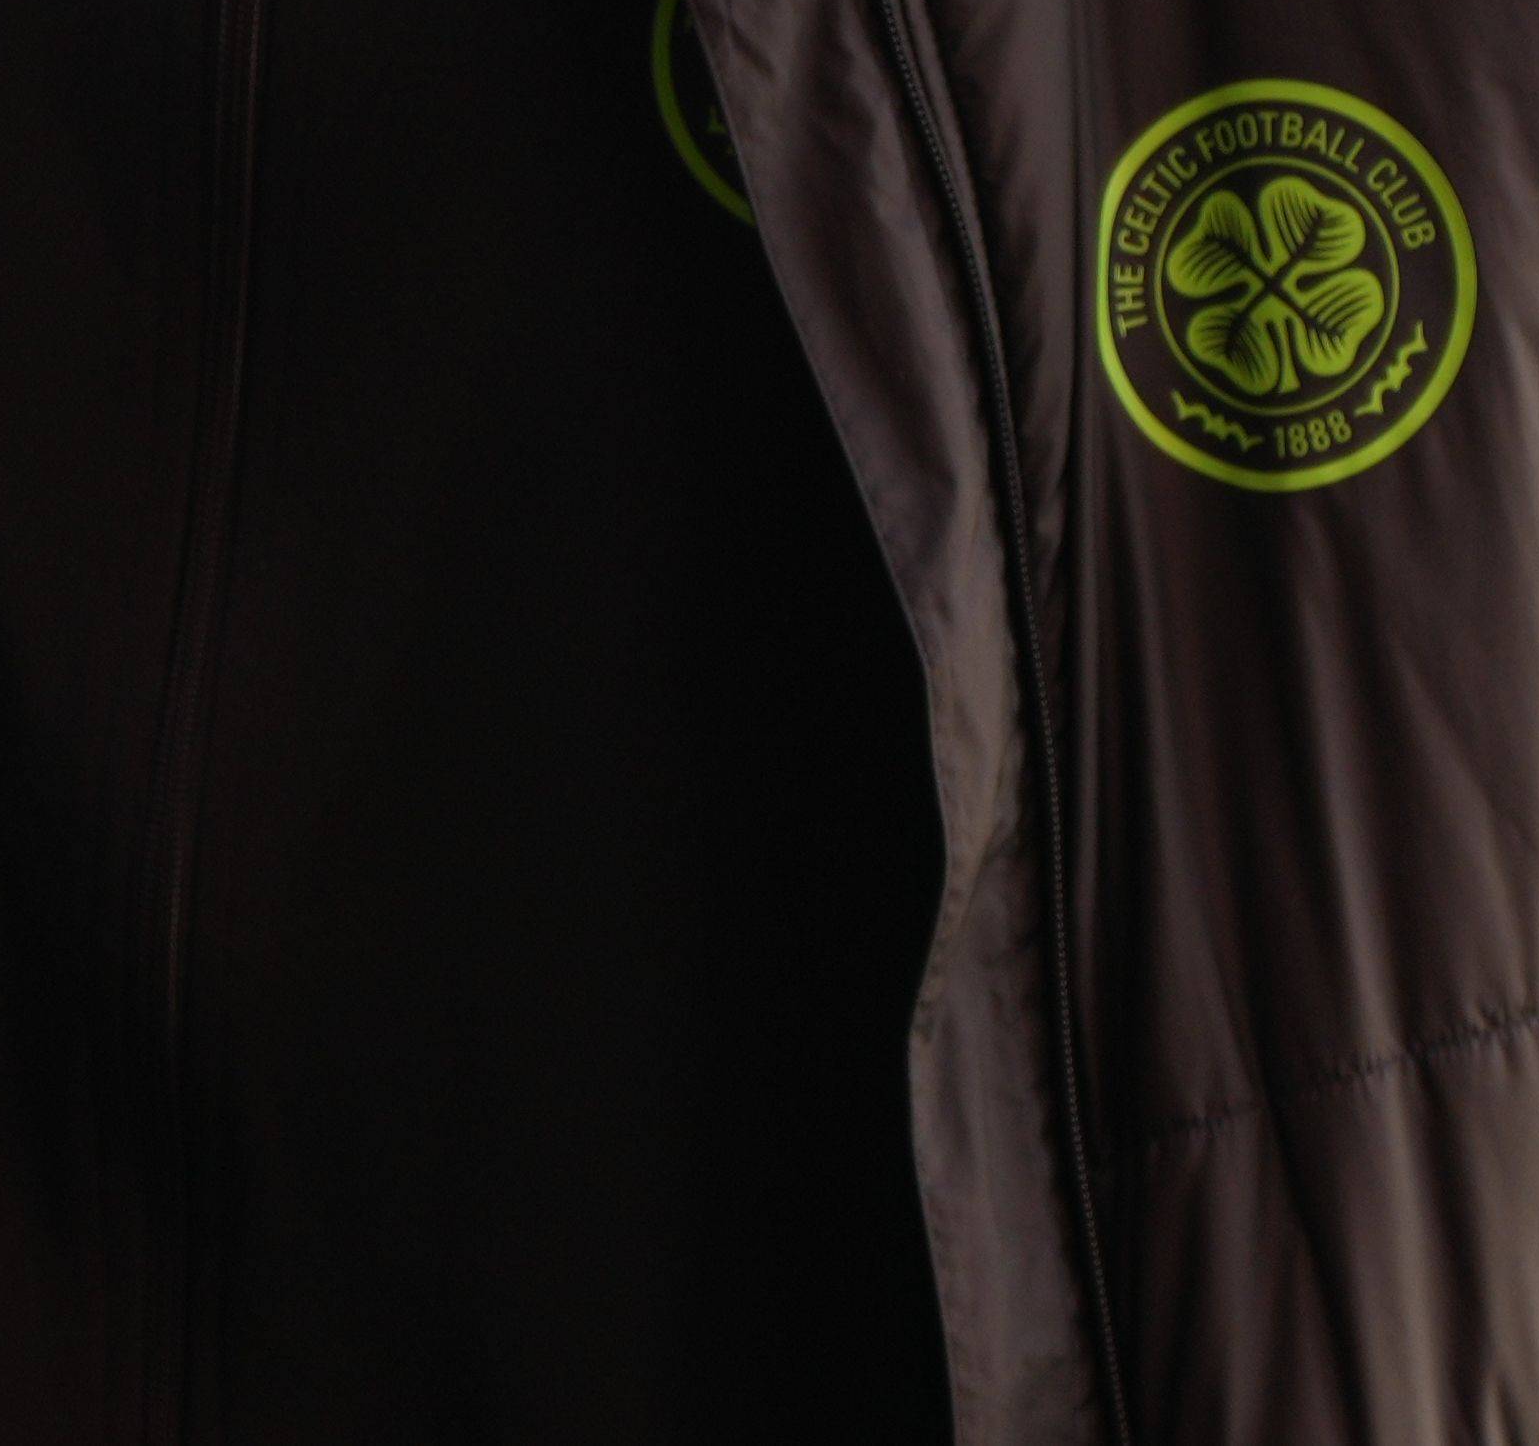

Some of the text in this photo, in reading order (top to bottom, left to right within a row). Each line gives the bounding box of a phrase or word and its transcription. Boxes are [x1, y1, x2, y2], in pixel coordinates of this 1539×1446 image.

[1114, 110, 1437, 339] THE CELTIC FOOTBALL CLUB
[1273, 409, 1353, 459] 1888
